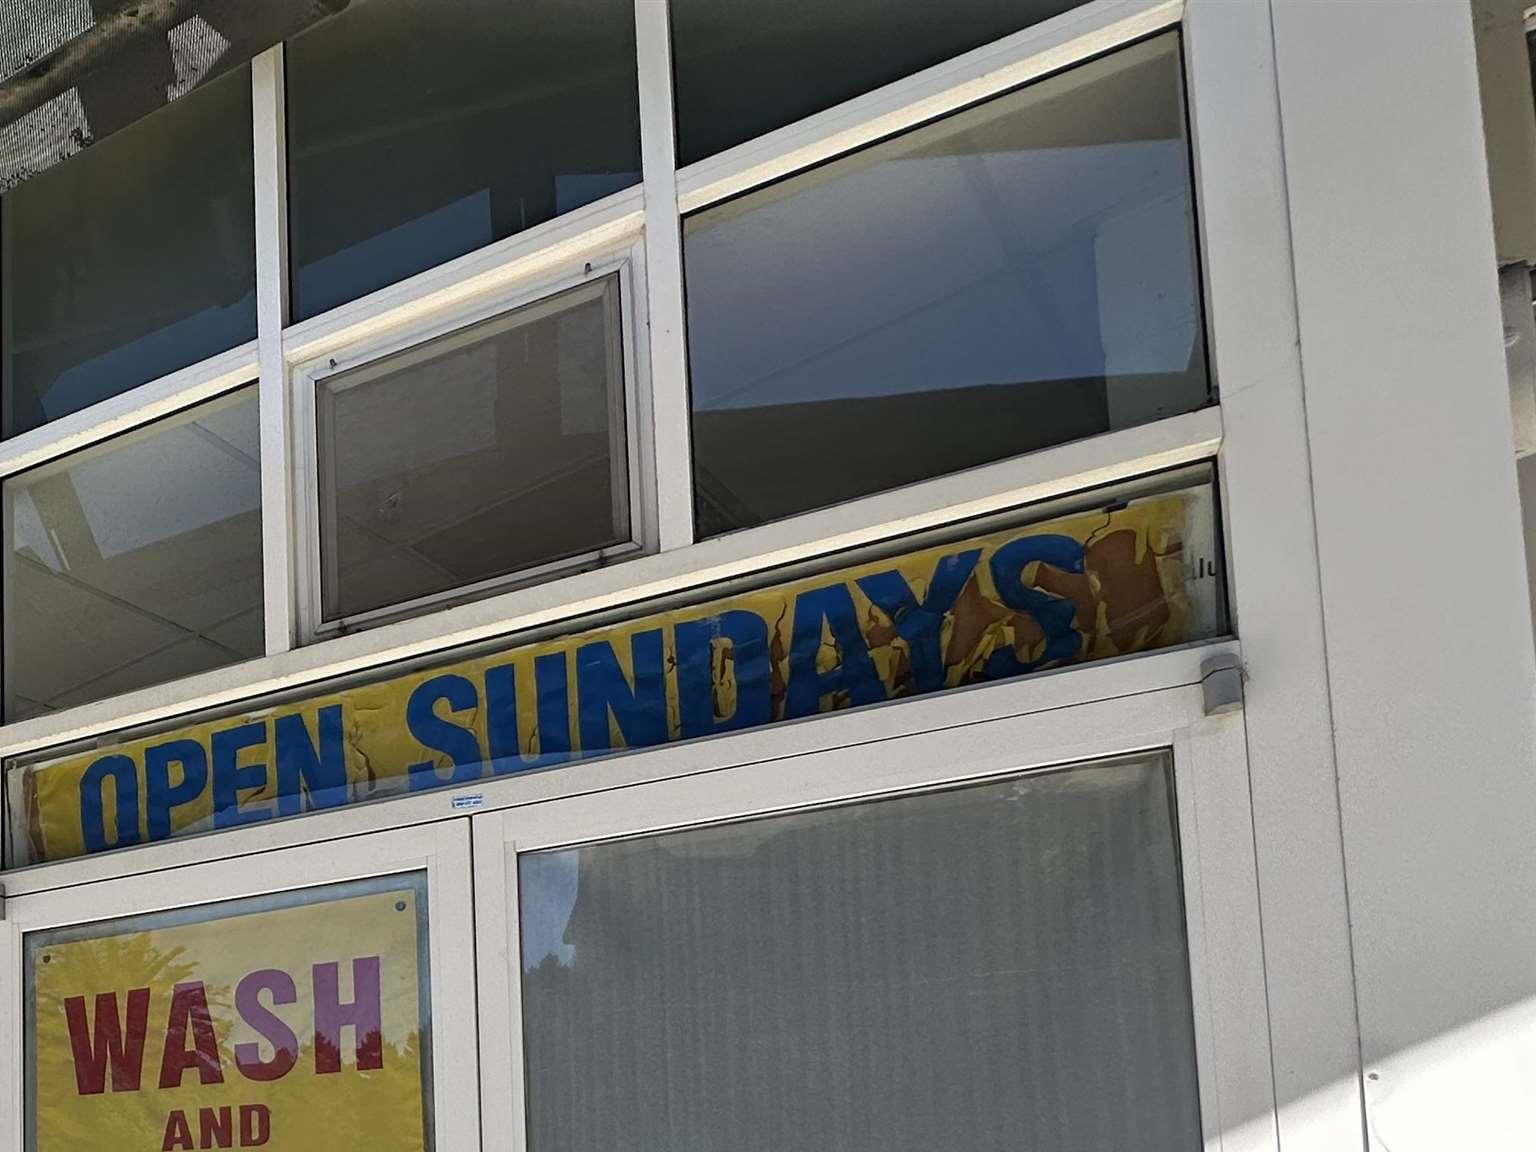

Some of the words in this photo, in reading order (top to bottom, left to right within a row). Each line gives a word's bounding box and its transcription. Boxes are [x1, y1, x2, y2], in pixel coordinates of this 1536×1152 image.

[79, 702, 349, 855] OPEN
[405, 533, 1087, 793] SUNDAYS
[64, 956, 384, 1096] WASH
[162, 1103, 272, 1152] AND
